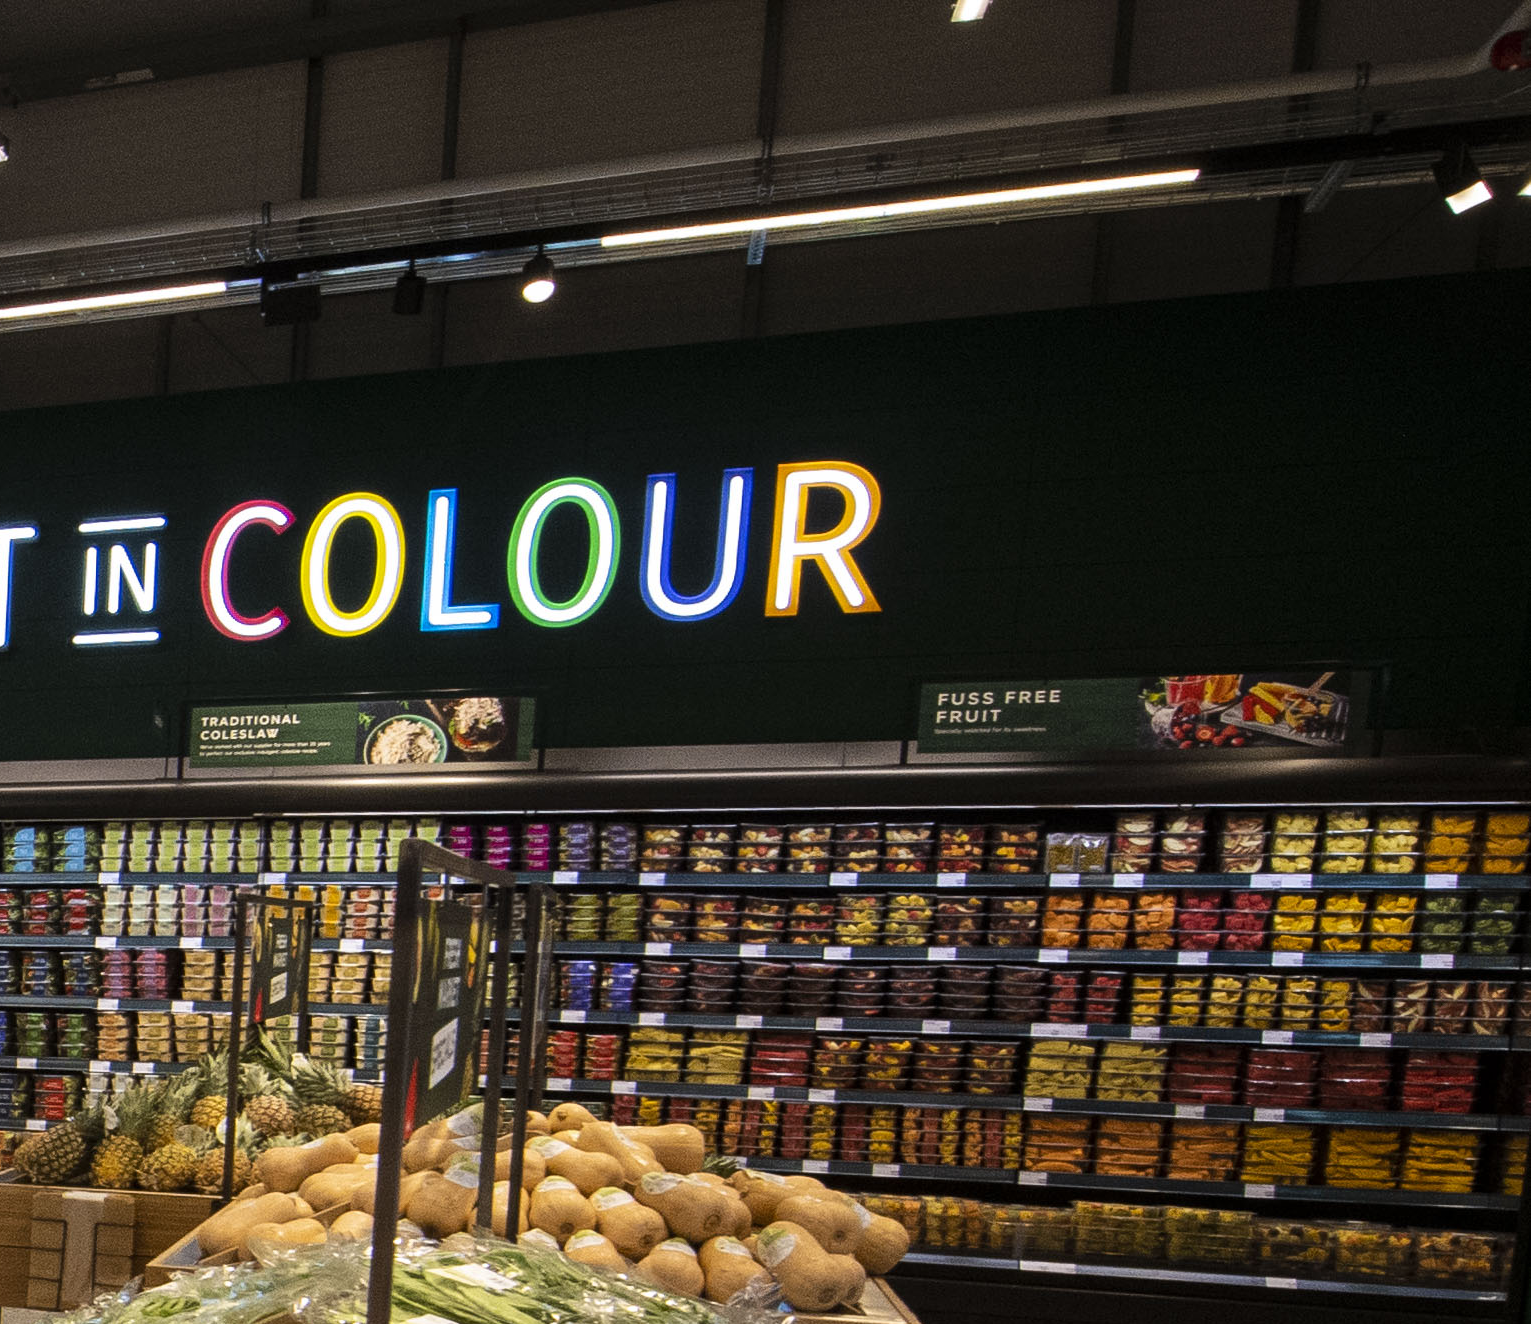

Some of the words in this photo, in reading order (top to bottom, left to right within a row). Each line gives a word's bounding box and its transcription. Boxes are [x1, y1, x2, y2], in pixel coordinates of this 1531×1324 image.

[81, 540, 159, 616] IN
[200, 459, 882, 643] COLOUR
[937, 692, 994, 706] FUSS
[1004, 689, 1061, 704] FREE
[201, 714, 300, 727] TRADITIONAL
[936, 709, 1001, 723] FRUIT
[200, 728, 279, 740] COLESLAW
